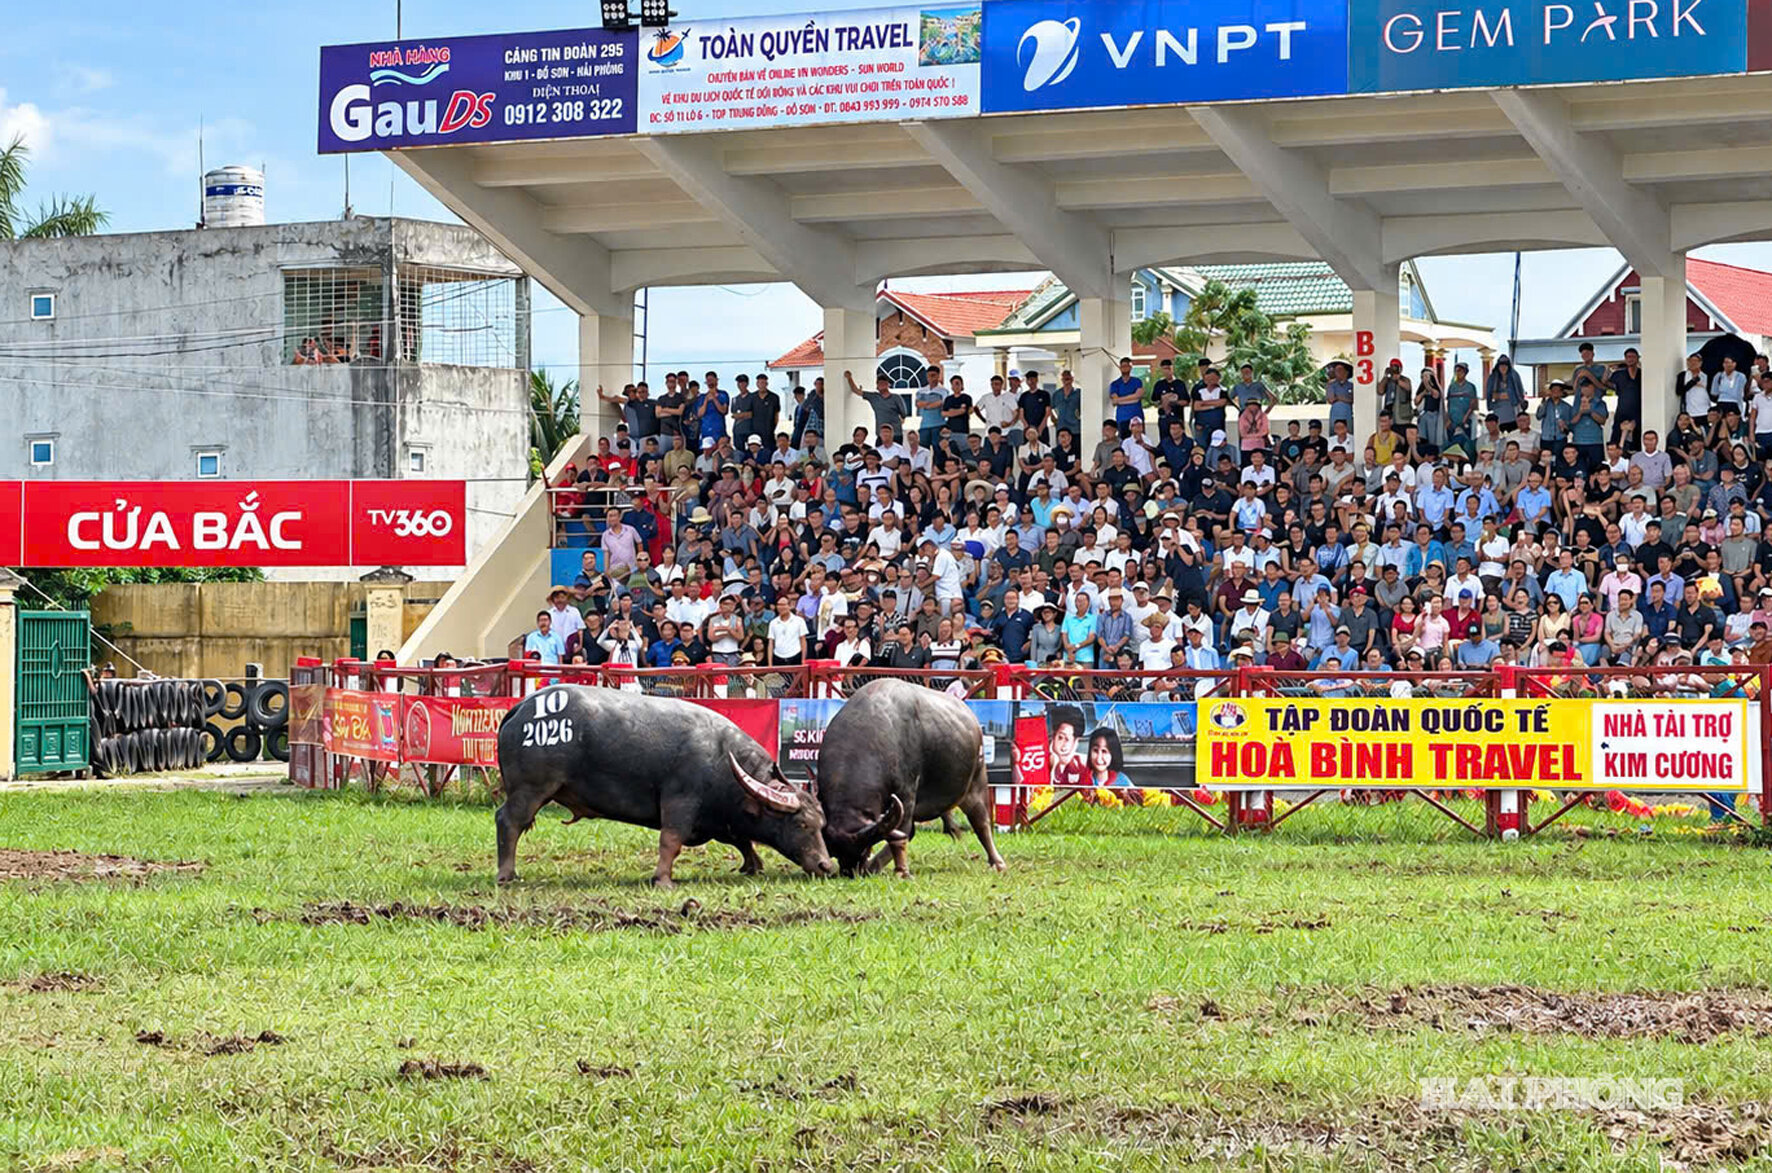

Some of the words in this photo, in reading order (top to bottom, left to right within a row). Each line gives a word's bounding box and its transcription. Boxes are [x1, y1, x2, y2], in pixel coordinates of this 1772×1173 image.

[699, 27, 754, 60] TOÀN
[760, 20, 829, 61] QUYỀN
[835, 23, 913, 51] TRAVEL
[1383, 8, 1514, 54] GEM
[1544, 0, 1706, 45] PARK
[370, 47, 403, 68] NHÀ
[406, 45, 450, 65] HÀNG
[541, 47, 560, 61] TIN
[600, 43, 624, 58] 295
[1100, 21, 1306, 69] VNPT
[504, 70, 522, 81] KHU
[525, 70, 529, 80] 1
[810, 65, 849, 77] WONDERS
[858, 63, 874, 74] SUN
[877, 62, 904, 73] WORLD
[673, 93, 689, 104] KHU
[845, 83, 858, 94] VUI
[504, 103, 547, 125] 0912
[552, 101, 584, 122] 308
[590, 98, 623, 120] 322
[68, 499, 181, 550] CỬA
[193, 491, 302, 550] BẮC
[368, 509, 452, 537] TV360
[533, 690, 569, 719] 10
[522, 718, 573, 747] 2026
[1265, 704, 1320, 736] TẬP
[1330, 704, 1410, 732] ĐOÀN
[1421, 703, 1505, 734] QUỐC
[1514, 703, 1552, 733] TẾ
[1604, 709, 1647, 738] NHÀ
[1653, 709, 1686, 738] TÀI
[1692, 711, 1733, 743] TRỢ
[1022, 751, 1045, 771] 5G
[1211, 736, 1296, 778] HOÀ
[1310, 736, 1413, 779] BÌNH
[1429, 743, 1583, 781] TRAVEL
[1604, 752, 1648, 778] KIM
[1654, 751, 1733, 780] CƯƠNG
